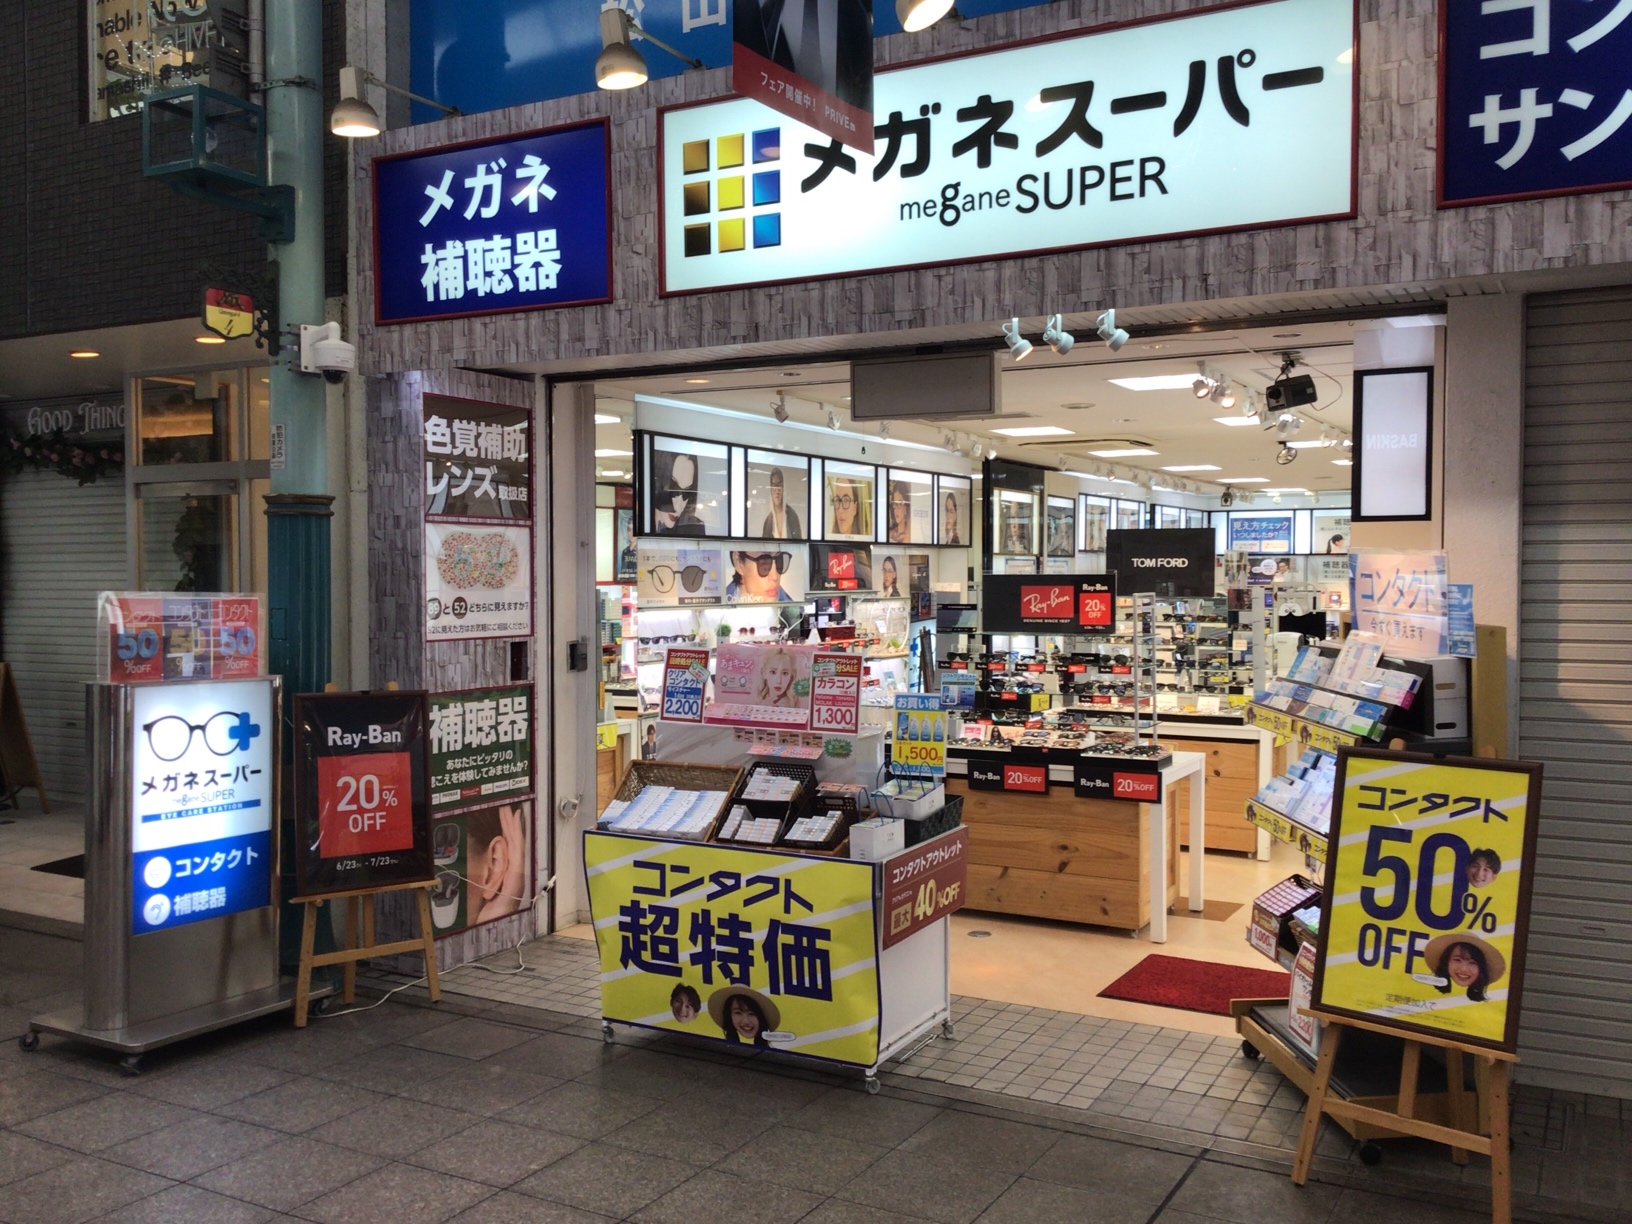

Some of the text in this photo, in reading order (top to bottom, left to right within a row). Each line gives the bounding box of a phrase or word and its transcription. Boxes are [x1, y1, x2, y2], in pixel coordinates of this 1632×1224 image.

[801, 48, 1324, 193] メガネスーパー
[419, 154, 558, 228] メガネ
[420, 228, 562, 302] 補聴器
[27, 406, 73, 436] GOOD
[424, 414, 526, 464] 色覚補助
[425, 460, 498, 500] レンズ
[498, 484, 528, 502] 取扱店
[1233, 520, 1289, 531] 見え方チェック
[1131, 557, 1189, 568] TOM FORD
[1022, 587, 1070, 614] Ray-Ban
[1082, 583, 1108, 592] Ray-Ban
[1088, 611, 1102, 619] OFF
[117, 628, 159, 660] 50
[219, 626, 255, 657] 50
[817, 677, 855, 690] カラコン
[896, 696, 940, 710] お買い得
[327, 724, 402, 749] Ray-Ban
[428, 695, 529, 755] 補聴器
[446, 749, 513, 771] あなたにピッタリの
[141, 763, 262, 796] メガネスーパー
[973, 771, 1001, 782] Ray-Ban
[1080, 777, 1110, 788] Ray-Ban
[336, 773, 398, 812] 20%
[1358, 784, 1509, 824] コンタクト
[160, 802, 244, 821] EYE CARE STATION
[348, 811, 388, 833] OFF
[174, 846, 260, 879] コンタクト
[891, 839, 963, 884] コンタクトアウトレット
[173, 886, 227, 917] 補聴器
[631, 859, 814, 915] コンタクト
[618, 900, 833, 1002] 超特価
[1357, 923, 1431, 974] OFF
